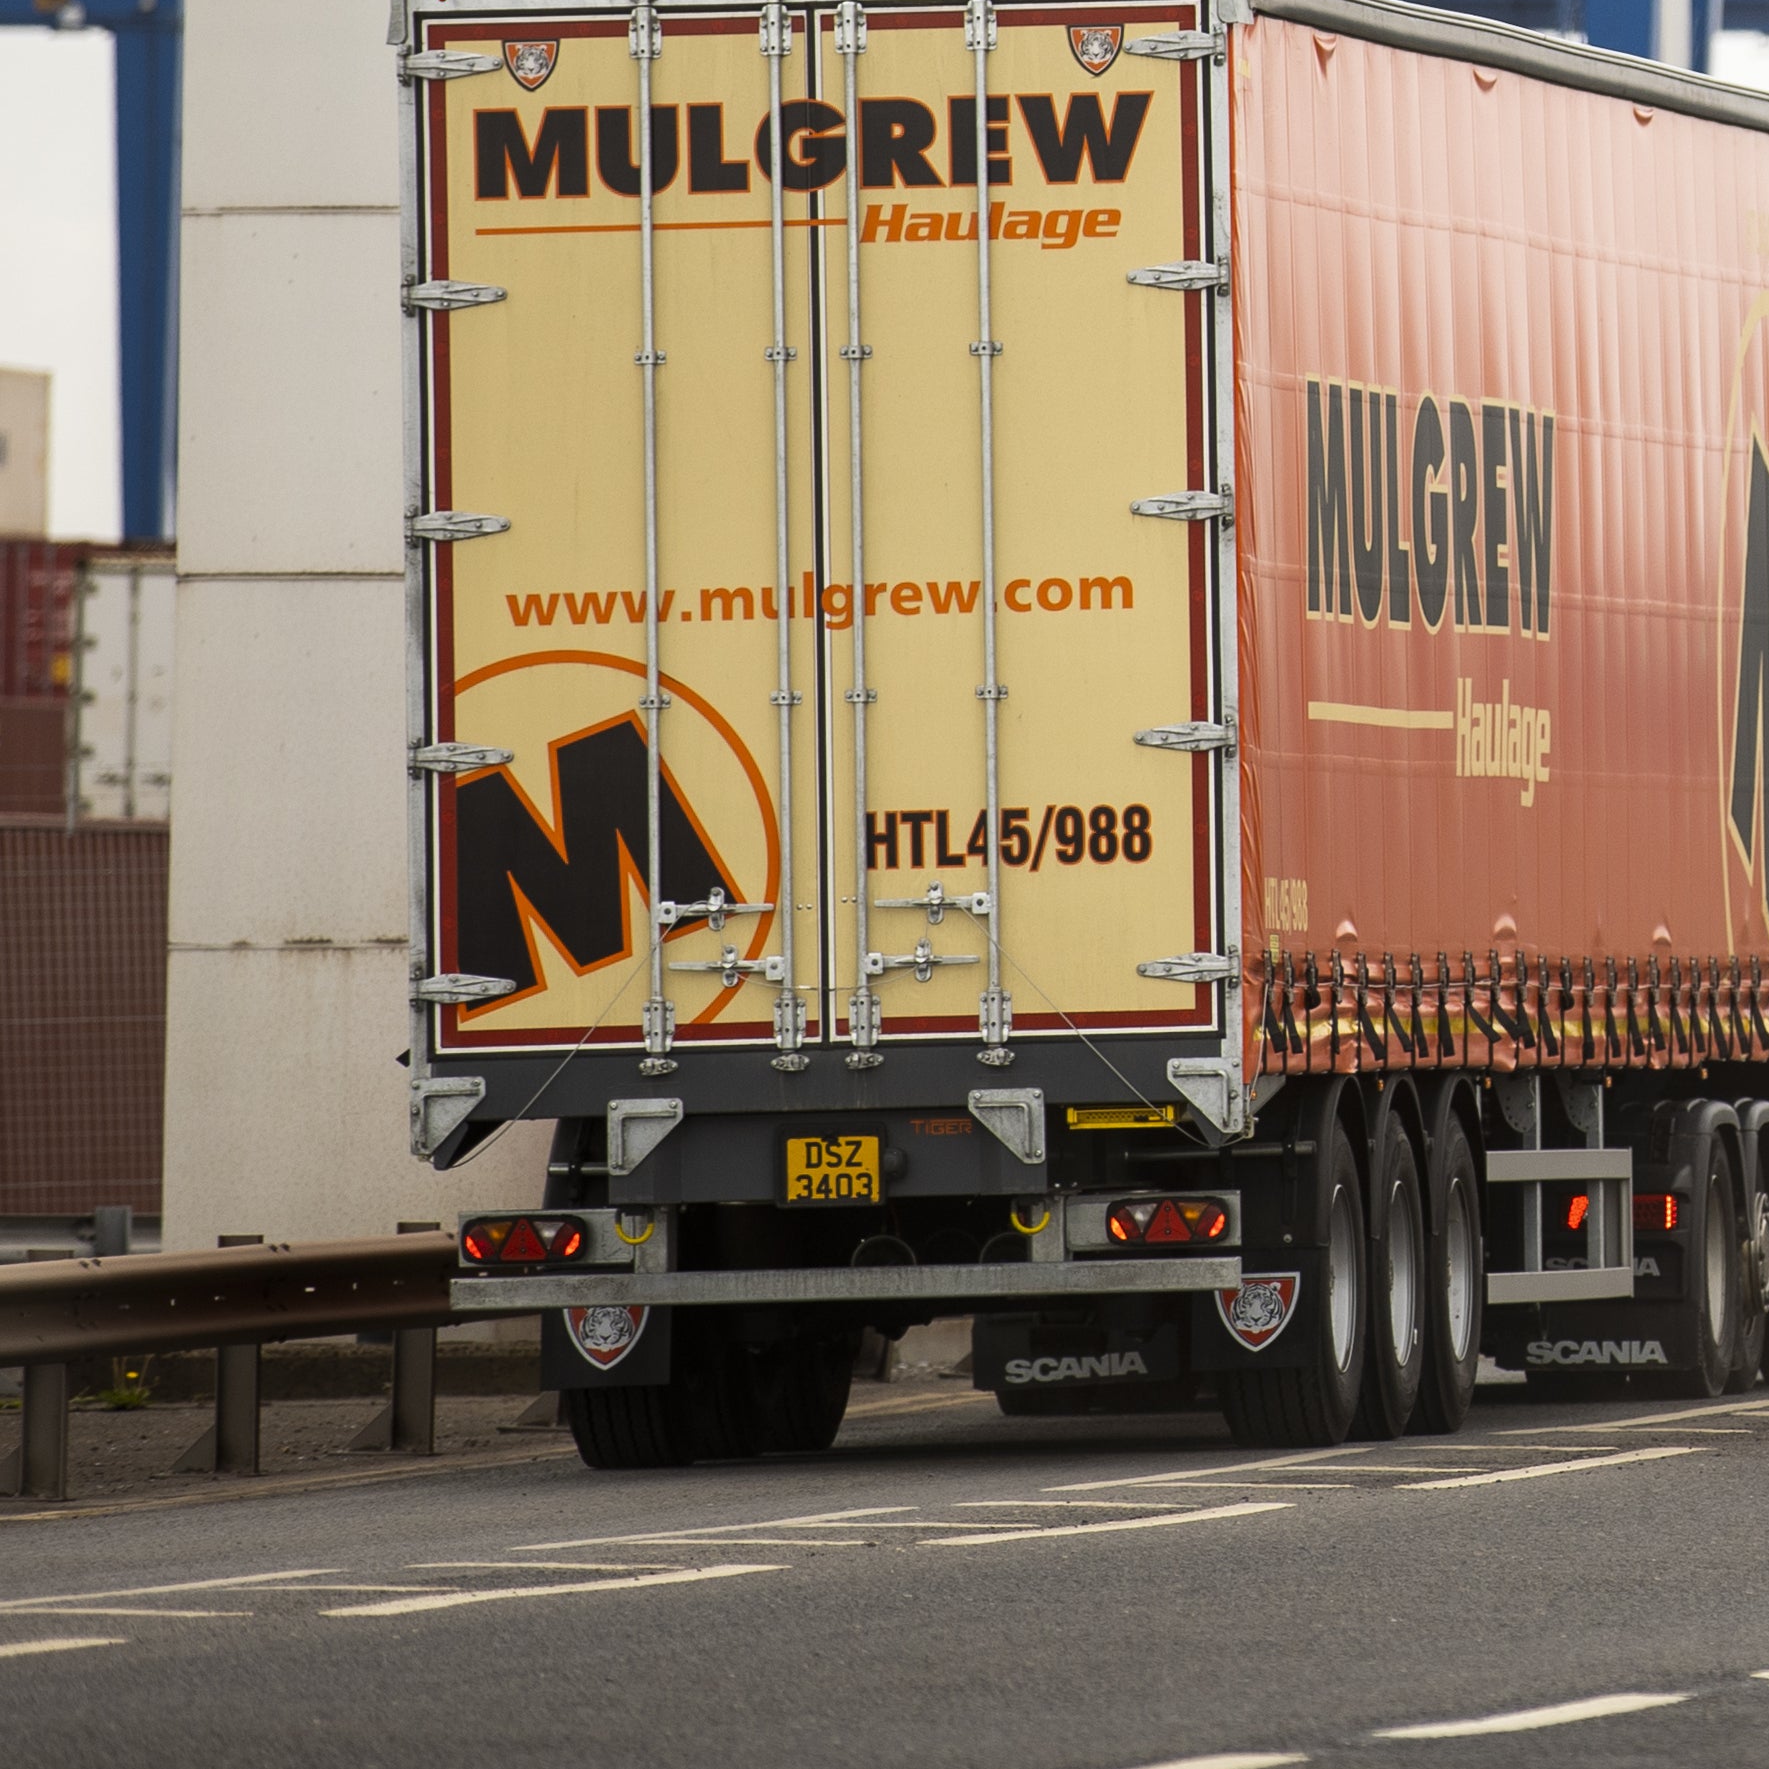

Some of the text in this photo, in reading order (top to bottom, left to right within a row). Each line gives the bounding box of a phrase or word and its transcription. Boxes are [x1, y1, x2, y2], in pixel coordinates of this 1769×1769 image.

[473, 90, 1155, 202] MULGREW
[861, 201, 1122, 250] Haulage
[1306, 372, 1556, 642] MULGREW
[506, 570, 1135, 630] www.mulgrewcom
[1456, 677, 1551, 808] Haulage
[866, 803, 1153, 873] HTL45/988
[909, 1118, 973, 1136] TIGER
[805, 1140, 863, 1169] DSZ
[796, 1172, 873, 1201] 3403
[1005, 1351, 1148, 1383] SCANIA
[1526, 1340, 1669, 1365] SCANIA
